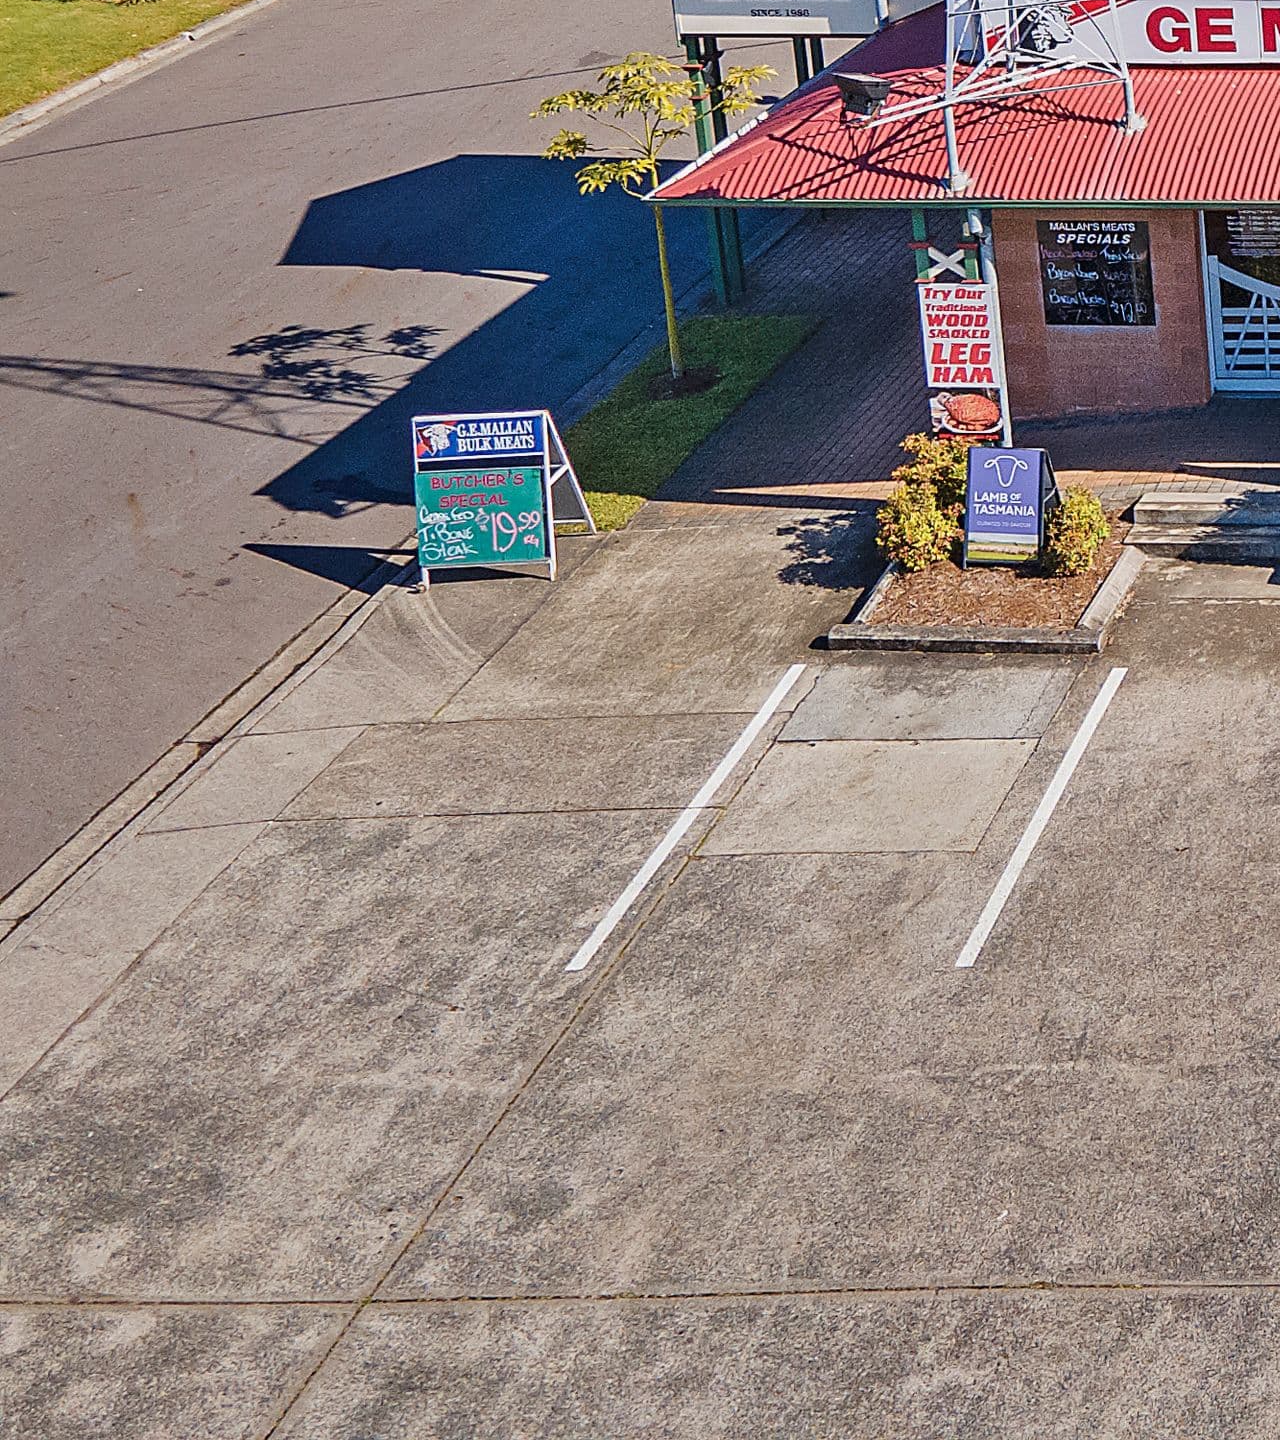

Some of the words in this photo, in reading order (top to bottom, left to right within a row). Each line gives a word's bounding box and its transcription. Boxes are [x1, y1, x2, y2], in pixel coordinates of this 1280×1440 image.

[751, 9, 783, 17] SINCE
[1146, 7, 1237, 53] GE
[1049, 222, 1099, 231] MALLAN'S
[1101, 222, 1136, 232] MEATS
[1056, 233, 1131, 244] SPECIALS
[924, 288, 952, 301] Try
[955, 288, 985, 299] Our
[925, 303, 987, 312] Traditional
[927, 314, 988, 327] WOOD
[928, 329, 990, 338] SMOKED
[931, 343, 991, 365] LEG
[933, 367, 994, 383] HAM
[456, 420, 533, 437] G.E.MALLAN
[457, 437, 493, 452] BULK
[494, 435, 535, 450] MEATS
[431, 473, 525, 490] BUTCHER'S
[440, 493, 508, 508] SPECIAL
[974, 491, 1008, 502] LAMB
[973, 503, 1035, 516] TASMANIA
